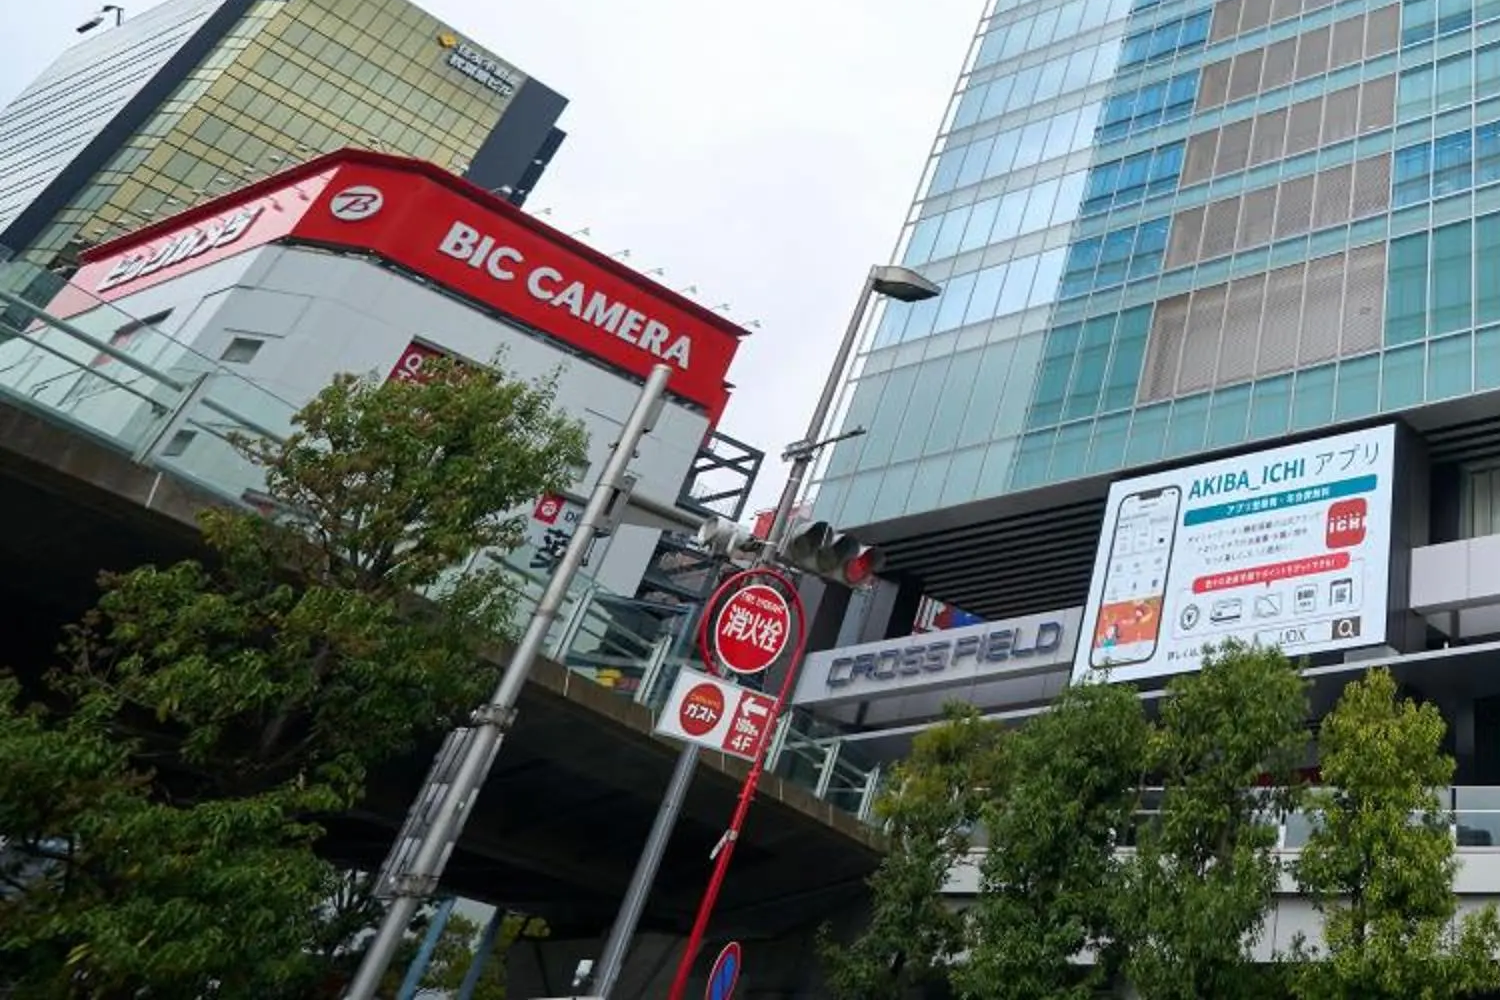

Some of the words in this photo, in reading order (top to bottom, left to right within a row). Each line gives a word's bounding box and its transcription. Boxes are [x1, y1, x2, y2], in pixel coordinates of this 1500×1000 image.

[437, 220, 525, 282] BIC
[527, 265, 693, 371] CAMERA
[1314, 441, 1380, 477] アプリ
[721, 603, 783, 653] 消火栓
[684, 703, 718, 723] ガスト
[731, 735, 754, 751] 4F
